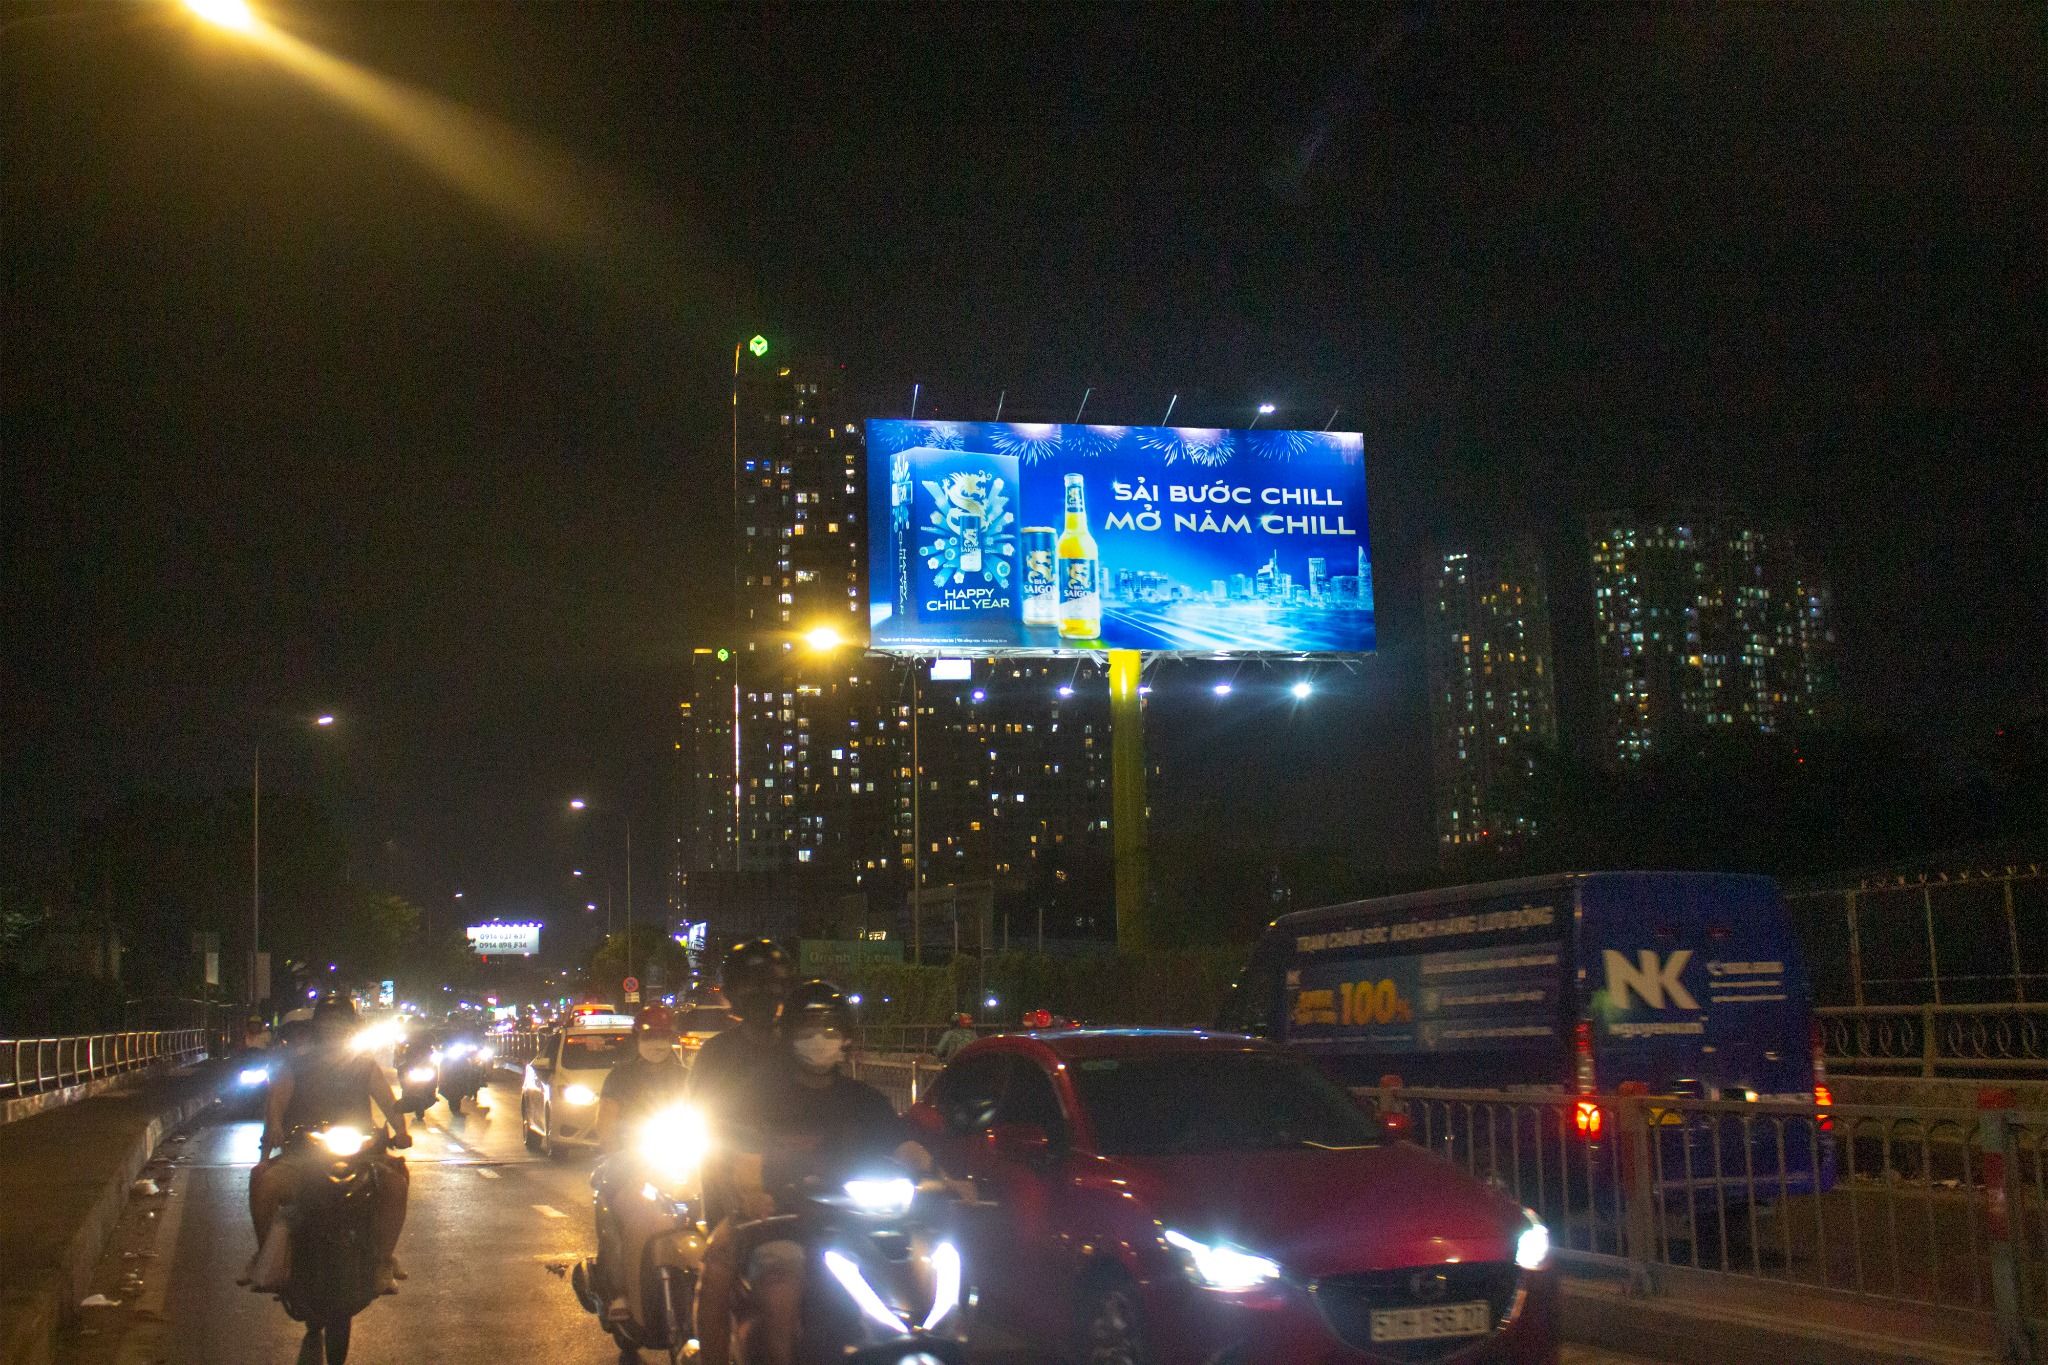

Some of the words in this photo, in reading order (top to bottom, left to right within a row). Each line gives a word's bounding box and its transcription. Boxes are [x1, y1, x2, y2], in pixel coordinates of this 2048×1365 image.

[1114, 476, 1158, 501] SẢI
[1169, 479, 1252, 504] BƯỚC
[1261, 488, 1343, 506] CHILL
[1104, 504, 1162, 532] MỞ
[1174, 509, 1252, 534] NĂM
[1262, 515, 1356, 535] CHILL
[926, 600, 971, 611] CHILL
[972, 598, 1010, 609] YEAR
[944, 588, 995, 600] HAPPY
[1602, 949, 1701, 1010] NK
